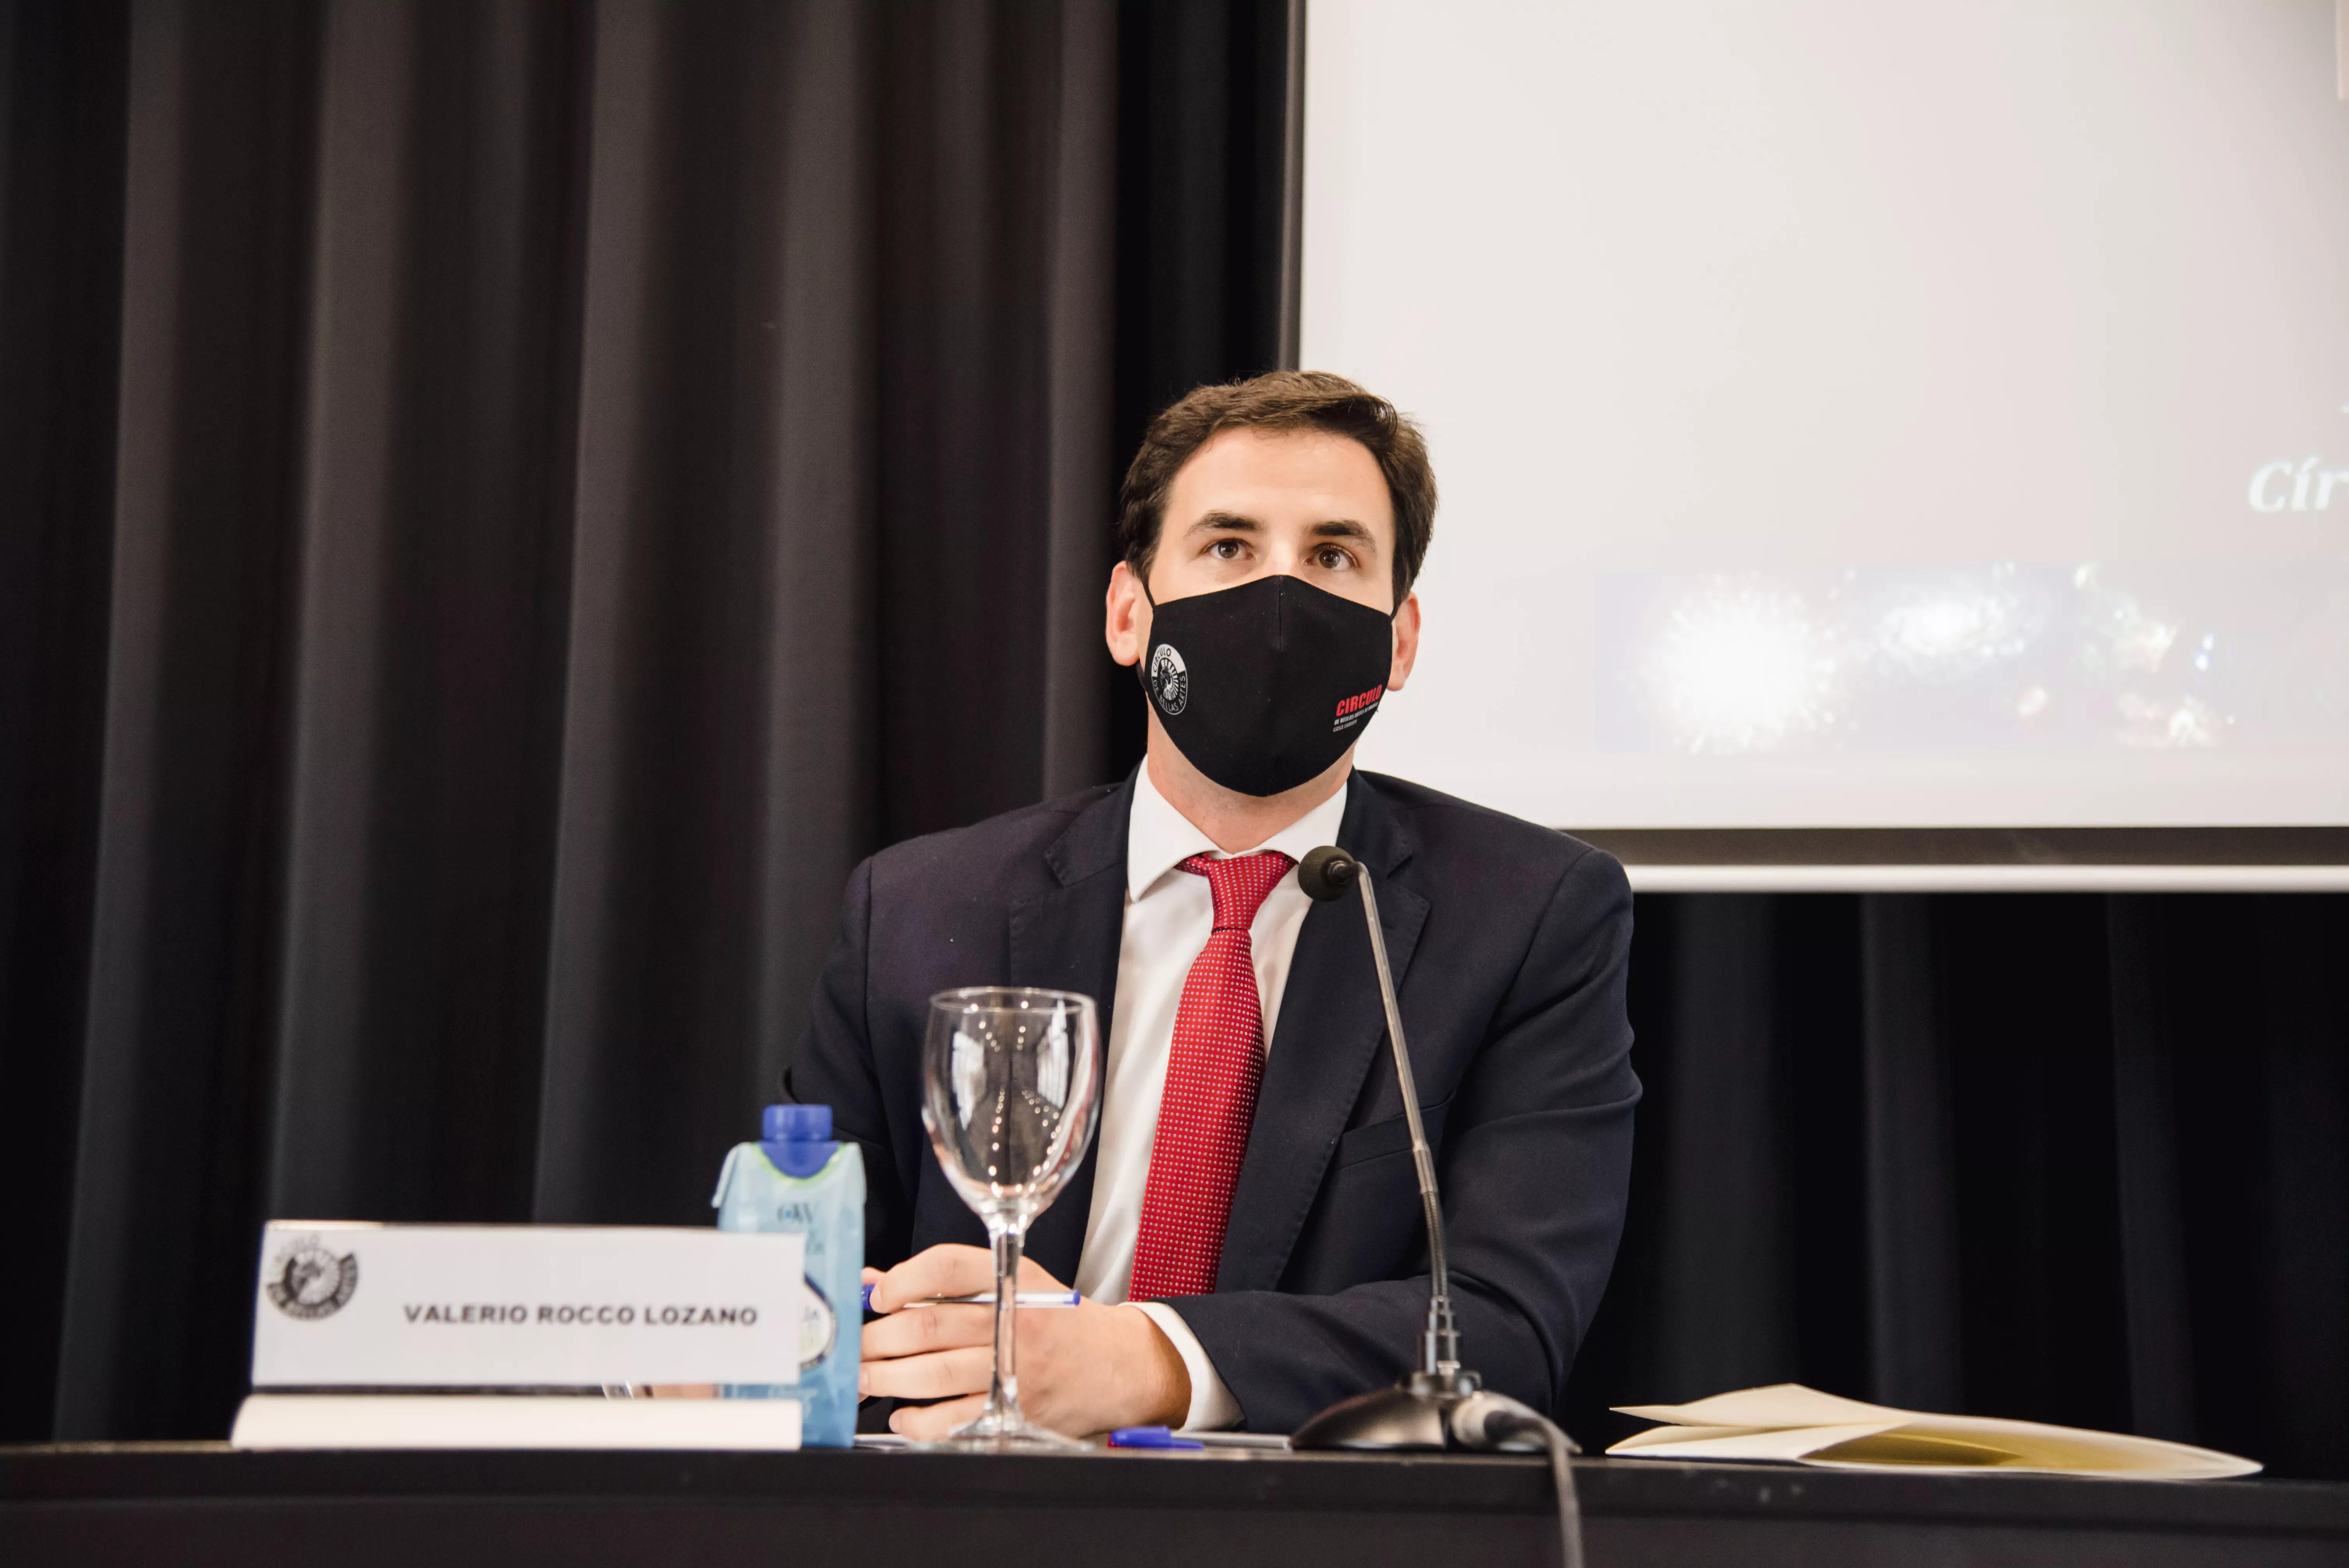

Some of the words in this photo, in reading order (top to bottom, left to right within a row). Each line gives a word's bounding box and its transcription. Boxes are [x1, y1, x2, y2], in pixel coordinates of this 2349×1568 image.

[1153, 647, 1171, 673] CIRCULO
[1153, 679, 1159, 692] DE
[1159, 695, 1179, 711] BELLAS
[1336, 684, 1382, 716] CIRCULO
[404, 1304, 528, 1324] VALERIO
[536, 1305, 635, 1324] ROCCO
[644, 1306, 757, 1325] LOZANO
